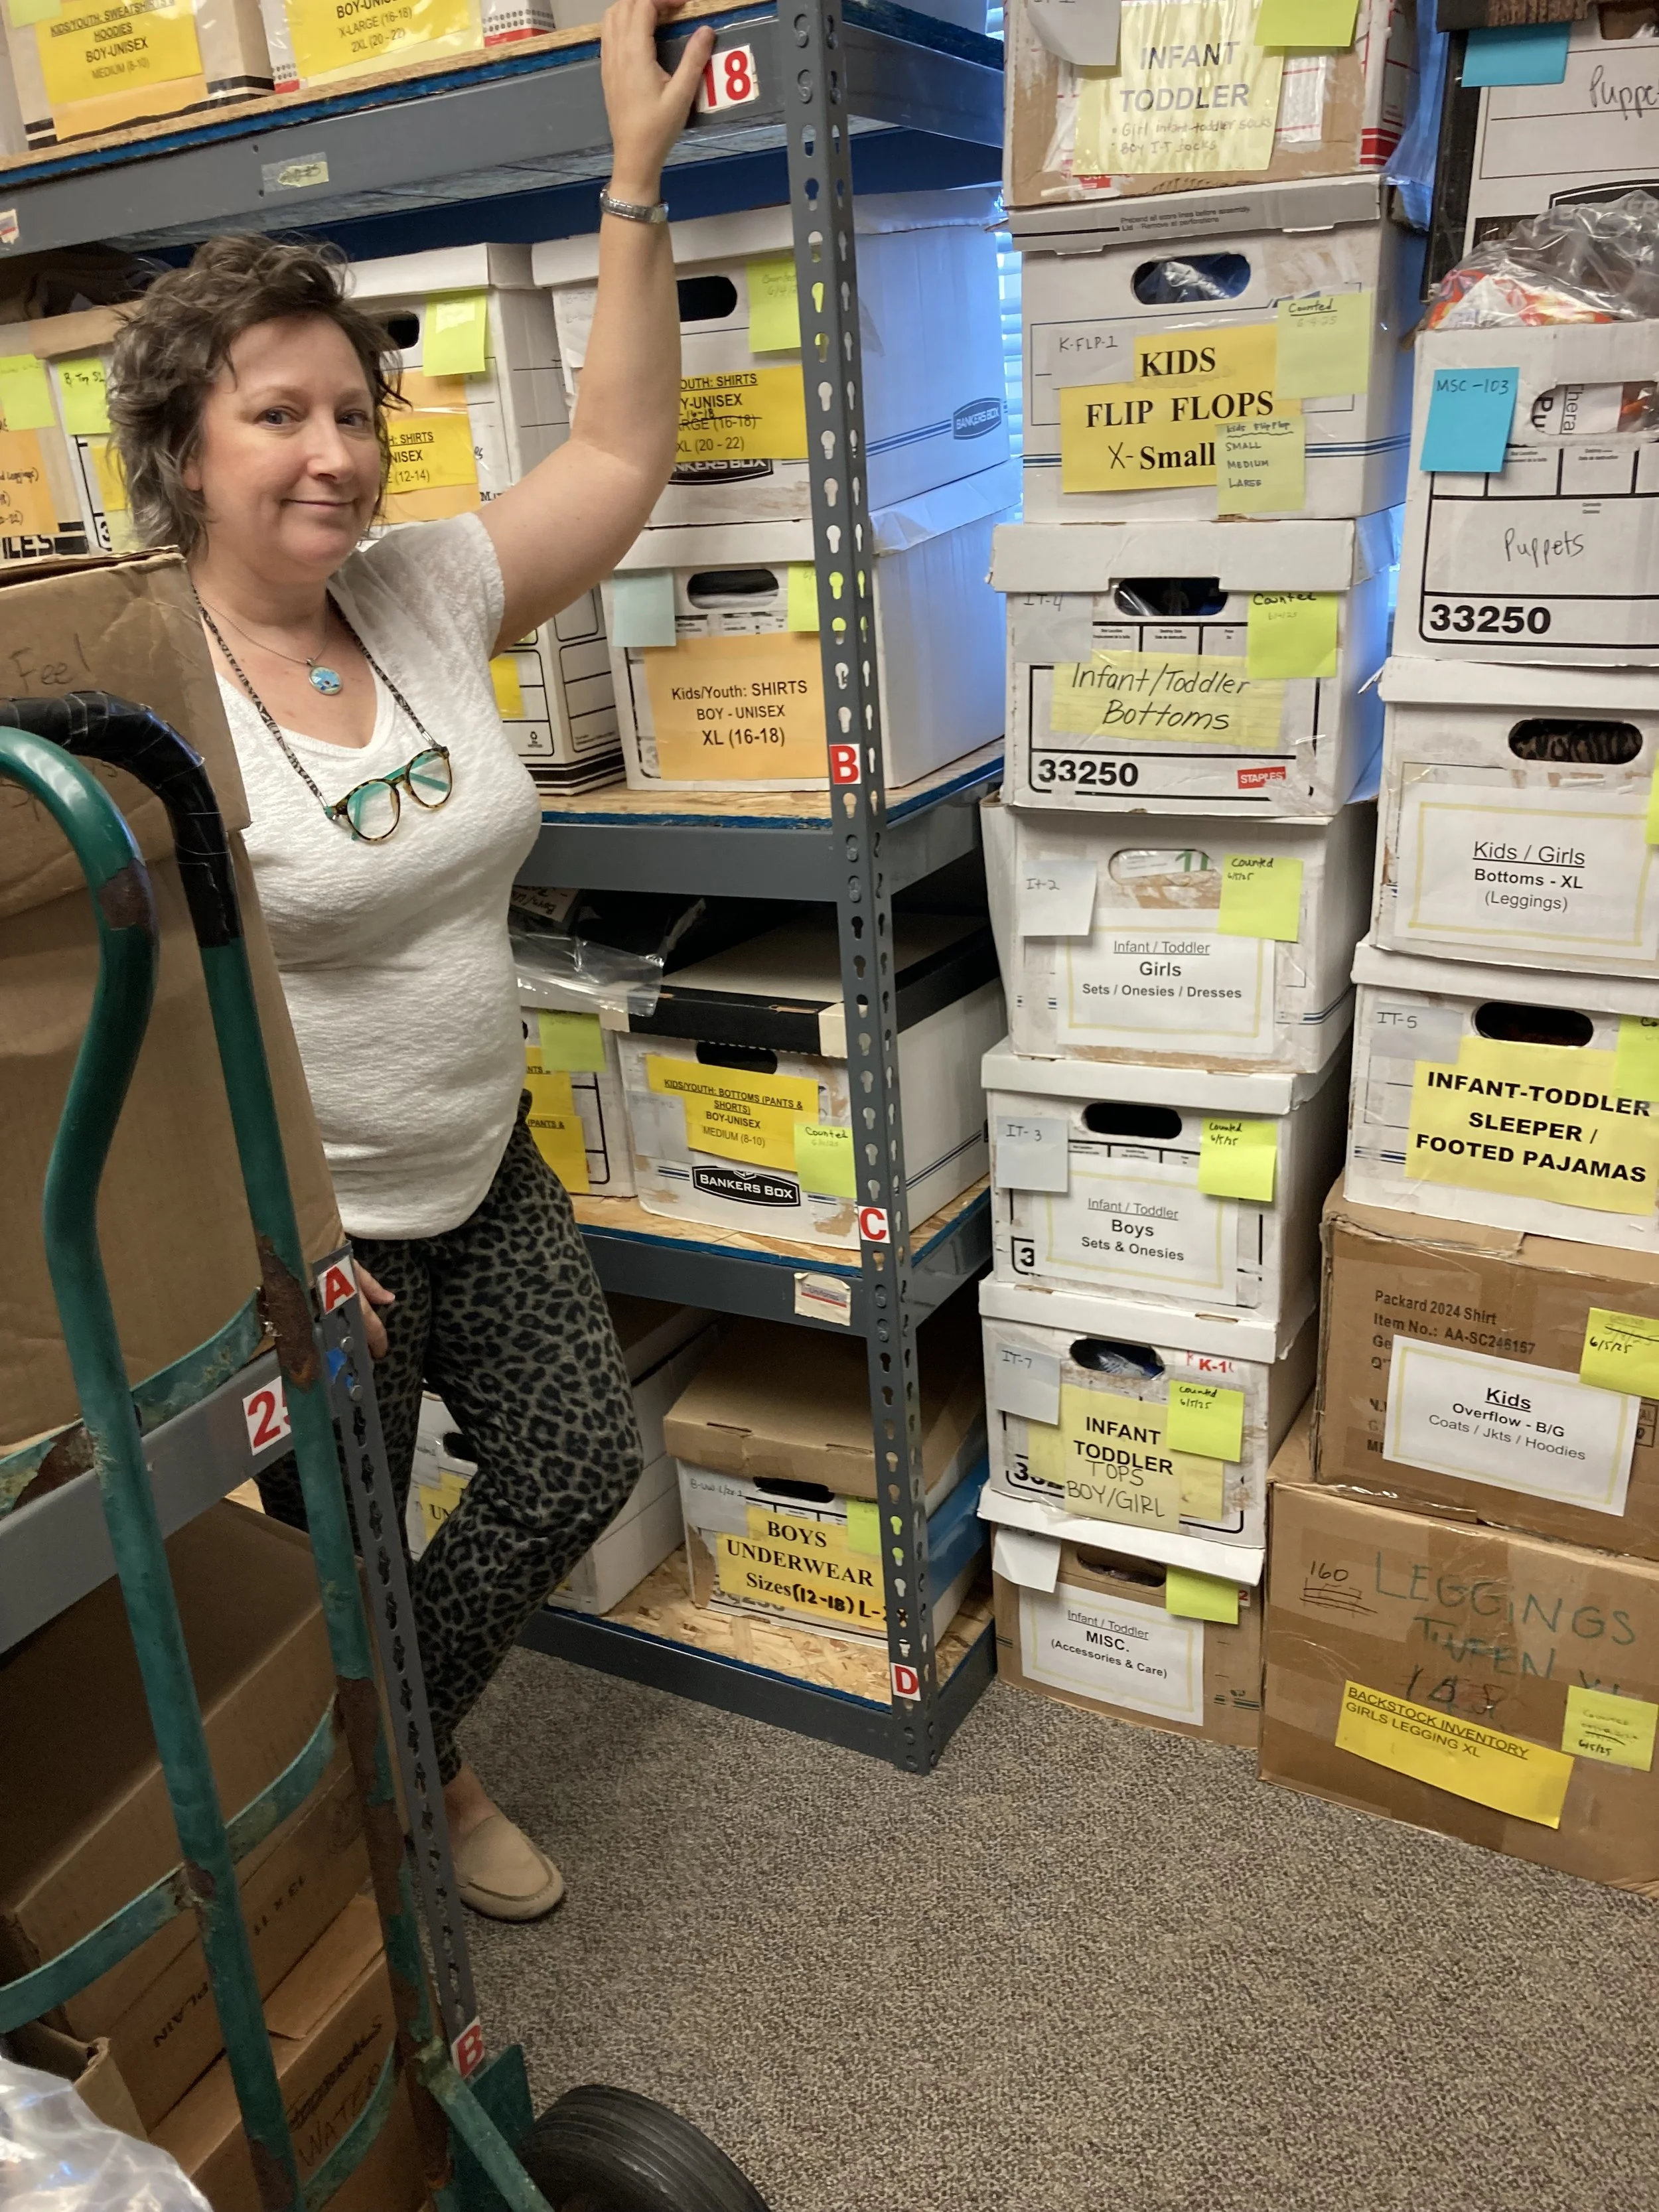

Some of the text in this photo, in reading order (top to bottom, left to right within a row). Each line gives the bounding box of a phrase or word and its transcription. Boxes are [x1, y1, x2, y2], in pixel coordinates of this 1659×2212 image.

[336, 0, 397, 19] BOY-UN
[338, 6, 412, 38] X-LARGE (16-18)
[94, 22, 133, 41] HOODIES
[86, 37, 149, 62] BOY-UNISEX
[351, 40, 368, 53] 2XL
[1140, 41, 1240, 70] INFANT
[92, 58, 150, 79] MEDIUM (8-10)
[703, 50, 751, 107] 18
[1119, 83, 1249, 113] TODDLER
[1589, 64, 1659, 121] Puppe
[1289, 298, 1334, 313] Counted
[1058, 335, 1119, 353] K-FLP-1
[1141, 346, 1216, 377] KIDS
[717, 373, 757, 387] SHIRTS
[680, 393, 743, 410] Y-UNISEX
[1085, 390, 1274, 428] FLIP FLOPS
[956, 407, 1000, 430] BANKERS BOX
[400, 431, 435, 444] SHIRTS
[677, 436, 745, 455] XL (20 22)
[1226, 441, 1262, 451] SMALL
[396, 467, 430, 486] (12-14)
[1227, 459, 1269, 469] MEDIUM
[1504, 528, 1584, 567] Puppets
[1253, 591, 1317, 606] Counted
[1430, 605, 1551, 634] 33250
[672, 680, 808, 700] Kids/Youth: SHIRTS
[697, 705, 785, 720] BOY UNISEX
[1102, 699, 1230, 730] Bottoms
[702, 727, 785, 748] XL (16-18)
[830, 745, 859, 784] B
[1038, 759, 1139, 787] 33250
[1240, 772, 1283, 784] STAPLES
[1474, 842, 1585, 865] Kids Girls
[1474, 868, 1583, 889] Bottoms XL
[1484, 891, 1568, 912] (Leggings)
[1114, 940, 1210, 954] Infant Toddler
[1139, 961, 1181, 977] Girls
[1082, 983, 1242, 999] Sets Onesies Dresses
[664, 1079, 803, 1109] KIDS/YOUTH: BOTTOMS (PANTS &
[1427, 1071, 1650, 1117] INFANT-TODDLER
[714, 1100, 751, 1114] SHORTS)
[706, 1111, 760, 1129] BOY-UNISEX
[1469, 1112, 1582, 1142] SLEEPER
[703, 1125, 765, 1148] MEDIUM (8-10)
[805, 1127, 848, 1139] Counted
[1416, 1134, 1646, 1183] FOOTED PAJAMAS
[700, 1174, 793, 1199] BANKERS BOX
[1088, 1197, 1179, 1219] Infant Toddler
[861, 1208, 887, 1240] C
[1112, 1219, 1154, 1238] Boys
[1081, 1237, 1184, 1261] Sets & Onesies
[325, 1264, 356, 1313] A
[1375, 1290, 1498, 1325] Packard 2024 Shirt
[1374, 1312, 1405, 1330] Item
[1407, 1319, 1437, 1337] No.:
[1589, 1336, 1633, 1354] 6/5/25
[1486, 1387, 1532, 1410] Kids
[248, 1389, 291, 1449] 2
[1086, 1416, 1161, 1445] INFANT
[1452, 1402, 1565, 1438] Overflow B/G
[1429, 1414, 1586, 1461] Coats Jkts Hoodies
[1074, 1440, 1173, 1475] TODDLER
[1085, 1459, 1144, 1486] TOPS
[1067, 1480, 1166, 1518] BOY/GIRL
[767, 1520, 827, 1547] BOYS
[727, 1539, 874, 1587] UNDERWEAR
[1311, 1561, 1348, 1582] 160
[1376, 1552, 1636, 1645] LEGGINGS
[1068, 1610, 1149, 1639] Infant Toddler
[1086, 1630, 1130, 1653] MISC.
[1051, 1638, 1167, 1679] (Accessories & Care)
[895, 1664, 918, 1695] D
[1346, 1702, 1481, 1757] GIRLS LEGGING XL
[1348, 1686, 1437, 1727] BACKSTOCK
[1440, 1718, 1530, 1759] INVENTORY
[153, 1981, 208, 2048] PLAIN
[457, 2024, 485, 2079] B
